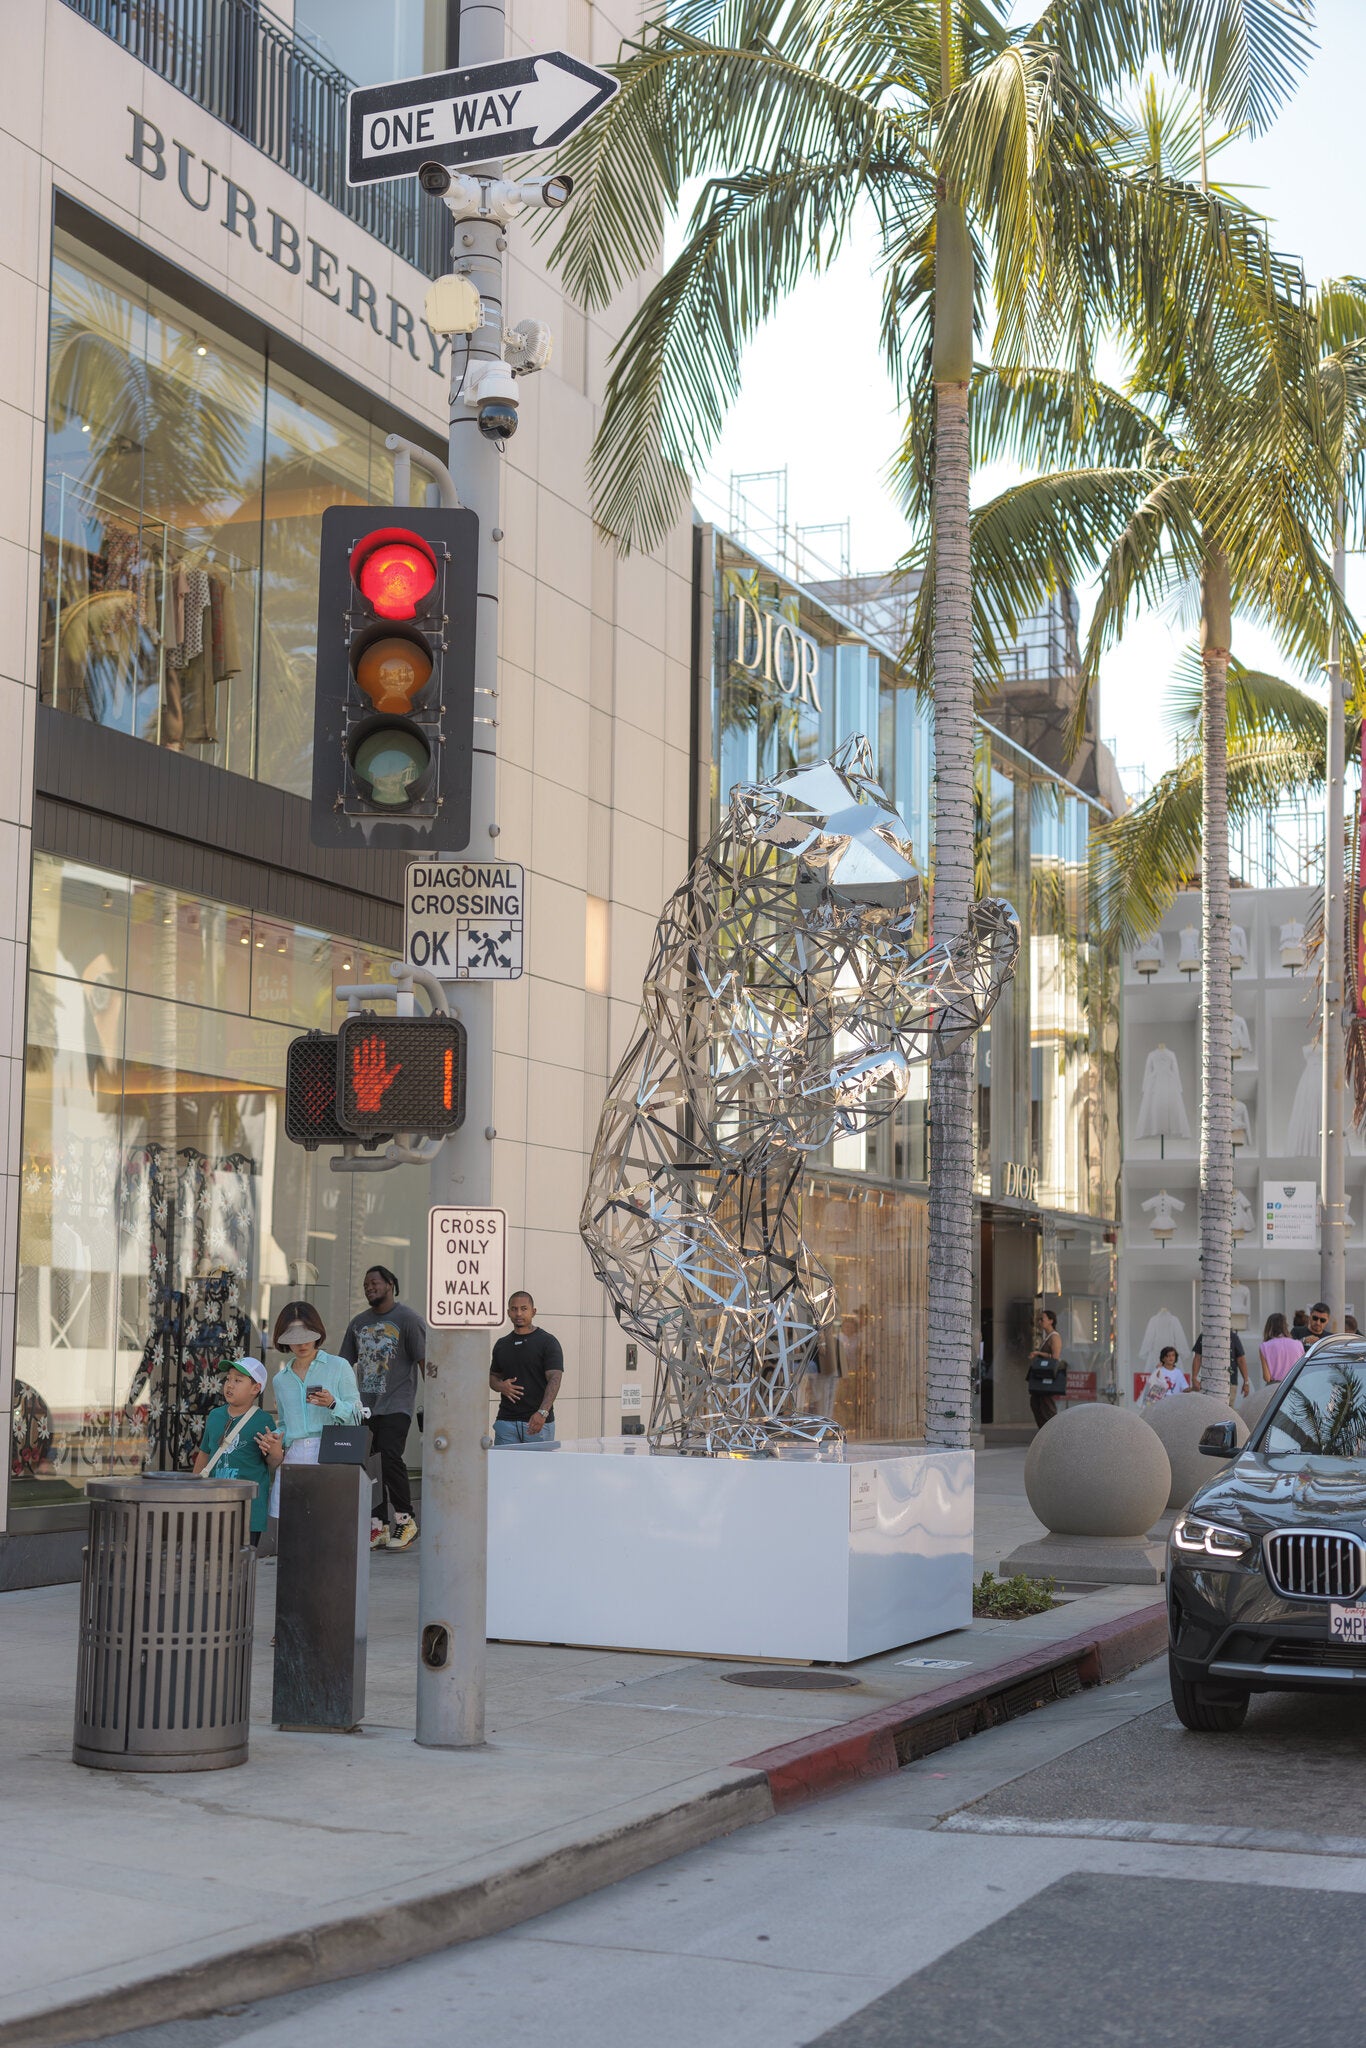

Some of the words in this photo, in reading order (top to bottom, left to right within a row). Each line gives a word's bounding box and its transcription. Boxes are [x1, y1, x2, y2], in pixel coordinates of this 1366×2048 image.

[370, 108, 434, 150] ONE
[453, 90, 522, 135] WAY
[125, 106, 452, 379] BURBERRY
[733, 594, 822, 713] DIOR
[413, 867, 517, 889] DIAGONAL
[411, 894, 520, 915] CROSSING
[410, 930, 450, 967] OK
[1006, 1161, 1039, 1203] DIOR
[440, 1218, 497, 1234] CROSS
[446, 1239, 489, 1254] ONLY
[457, 1259, 479, 1275] ON
[445, 1280, 490, 1295] WALK
[437, 1300, 498, 1316] SIGNAL
